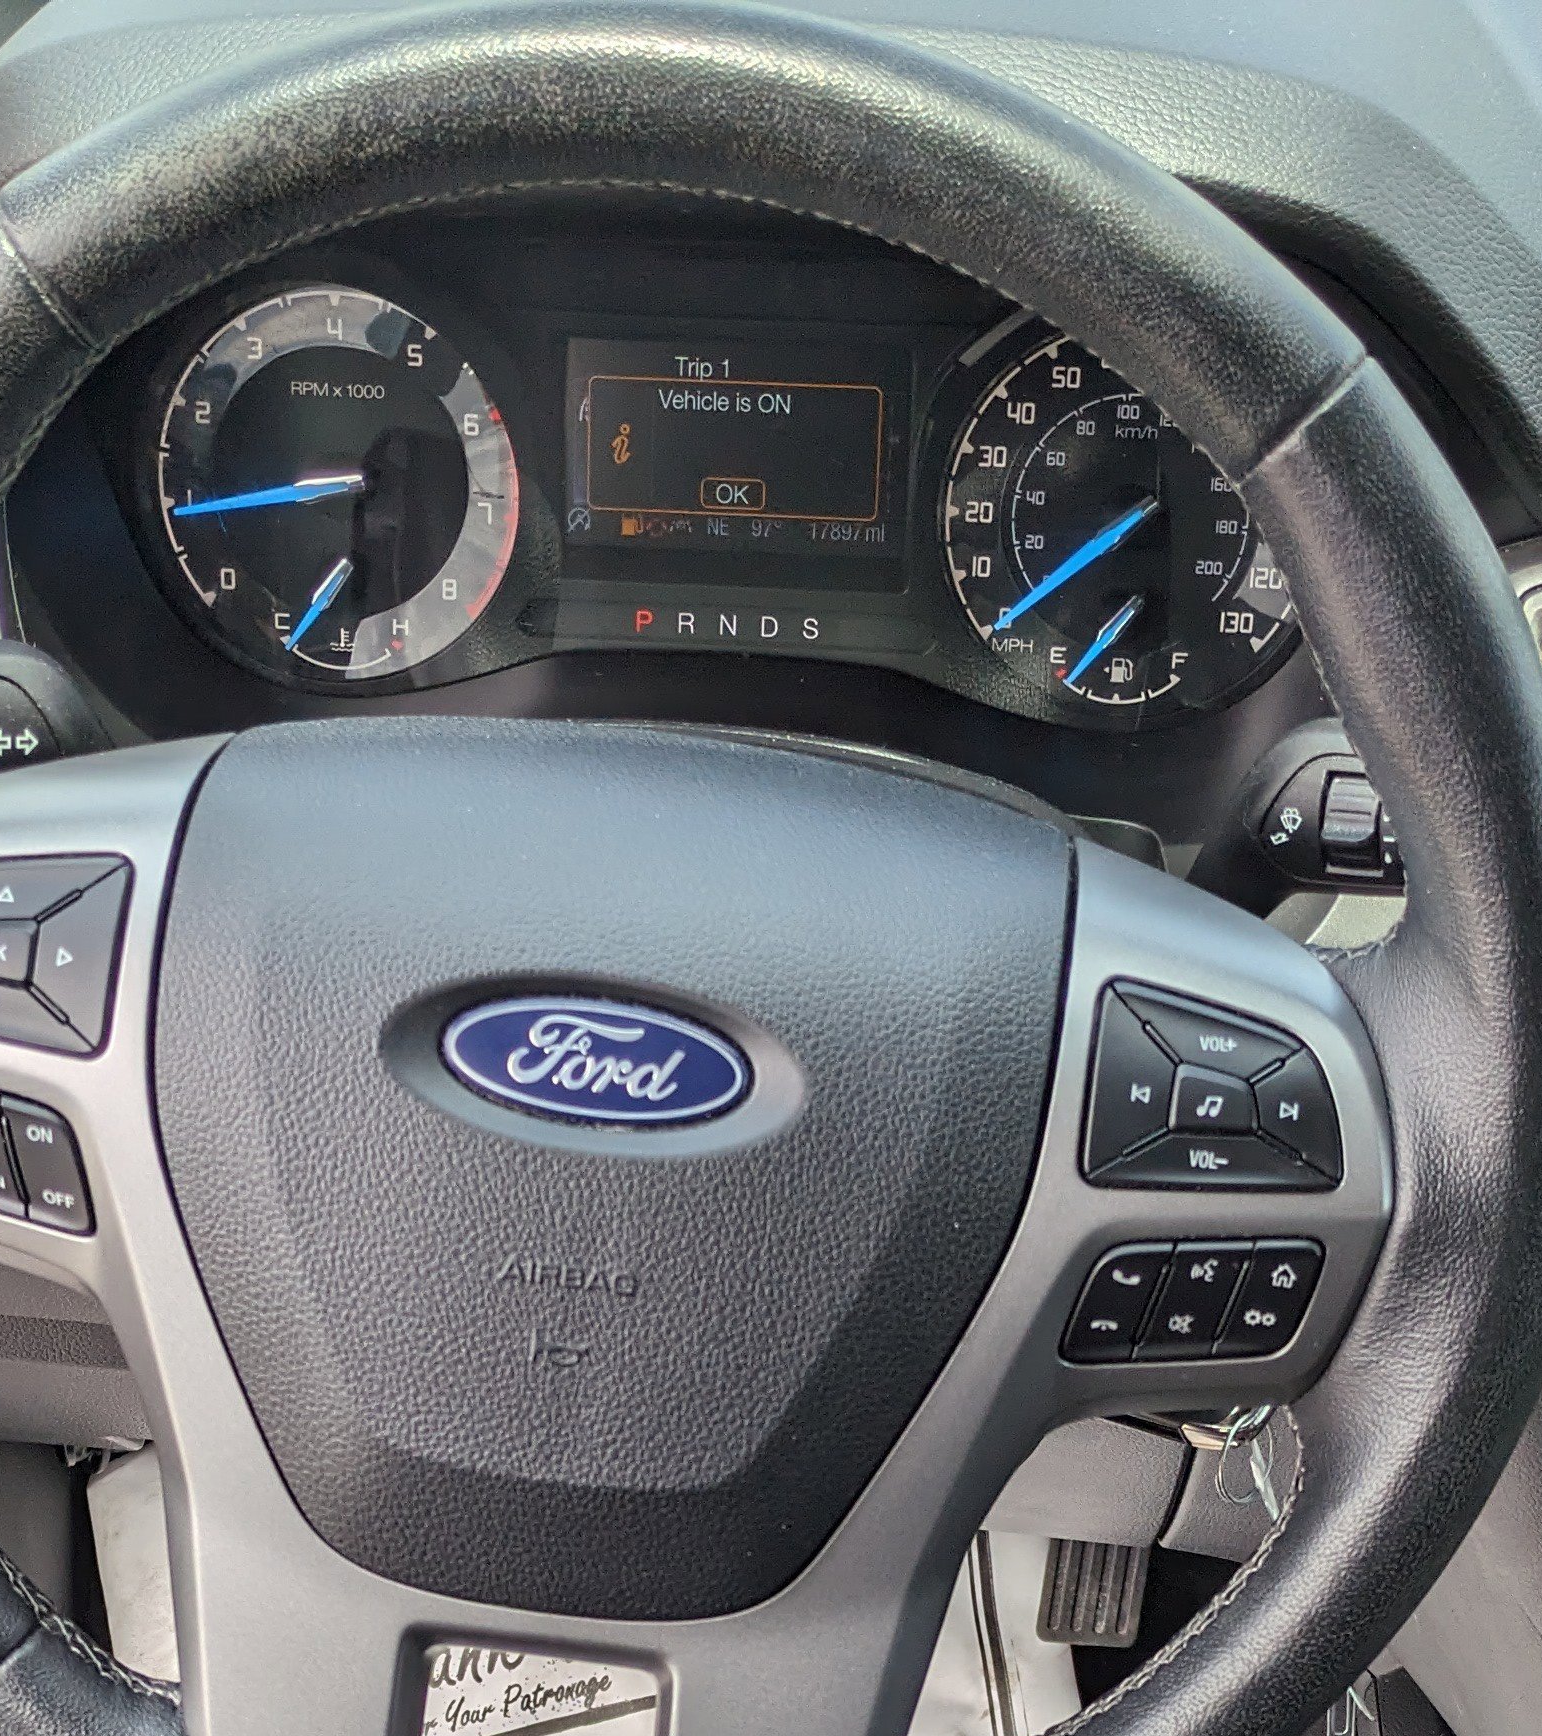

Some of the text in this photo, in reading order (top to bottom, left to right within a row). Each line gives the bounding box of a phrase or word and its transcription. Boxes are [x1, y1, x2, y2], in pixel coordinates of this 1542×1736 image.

[326, 317, 343, 341] 4
[247, 337, 263, 360] 3
[407, 344, 423, 367] 5
[675, 356, 730, 380] Trip 1
[1051, 366, 1081, 389] 50
[290, 381, 329, 397] RPM
[659, 389, 791, 414] Vehicle is ON
[1116, 404, 1140, 420] 100
[195, 401, 211, 424] 2
[1007, 402, 1036, 425] 40
[463, 413, 479, 436] 6
[1076, 420, 1095, 436] 80
[1114, 424, 1158, 440] km/h
[978, 446, 1007, 468] 30
[1046, 451, 1066, 466] 60
[715, 483, 749, 504] OK
[1026, 490, 1045, 505] 40
[478, 502, 492, 524] 7
[965, 501, 993, 523] 20
[1216, 520, 1237, 535] 180
[1025, 535, 1044, 549] 20
[971, 557, 991, 578] 10
[1195, 561, 1223, 576] 200
[220, 568, 236, 590] 0
[1249, 568, 1283, 589] 120
[442, 579, 457, 601] 8
[392, 619, 409, 636] H
[635, 609, 819, 640] P R N D S
[1219, 612, 1254, 634] 130
[991, 638, 1034, 654] MPH
[1050, 647, 1066, 664] E
[1171, 653, 1188, 670] F
[506, 1013, 687, 1101] Ford
[26, 1125, 53, 1144] ON
[41, 1188, 75, 1209] OFF
[445, 1696, 495, 1732] Your
[503, 1674, 613, 1718] Patronage
